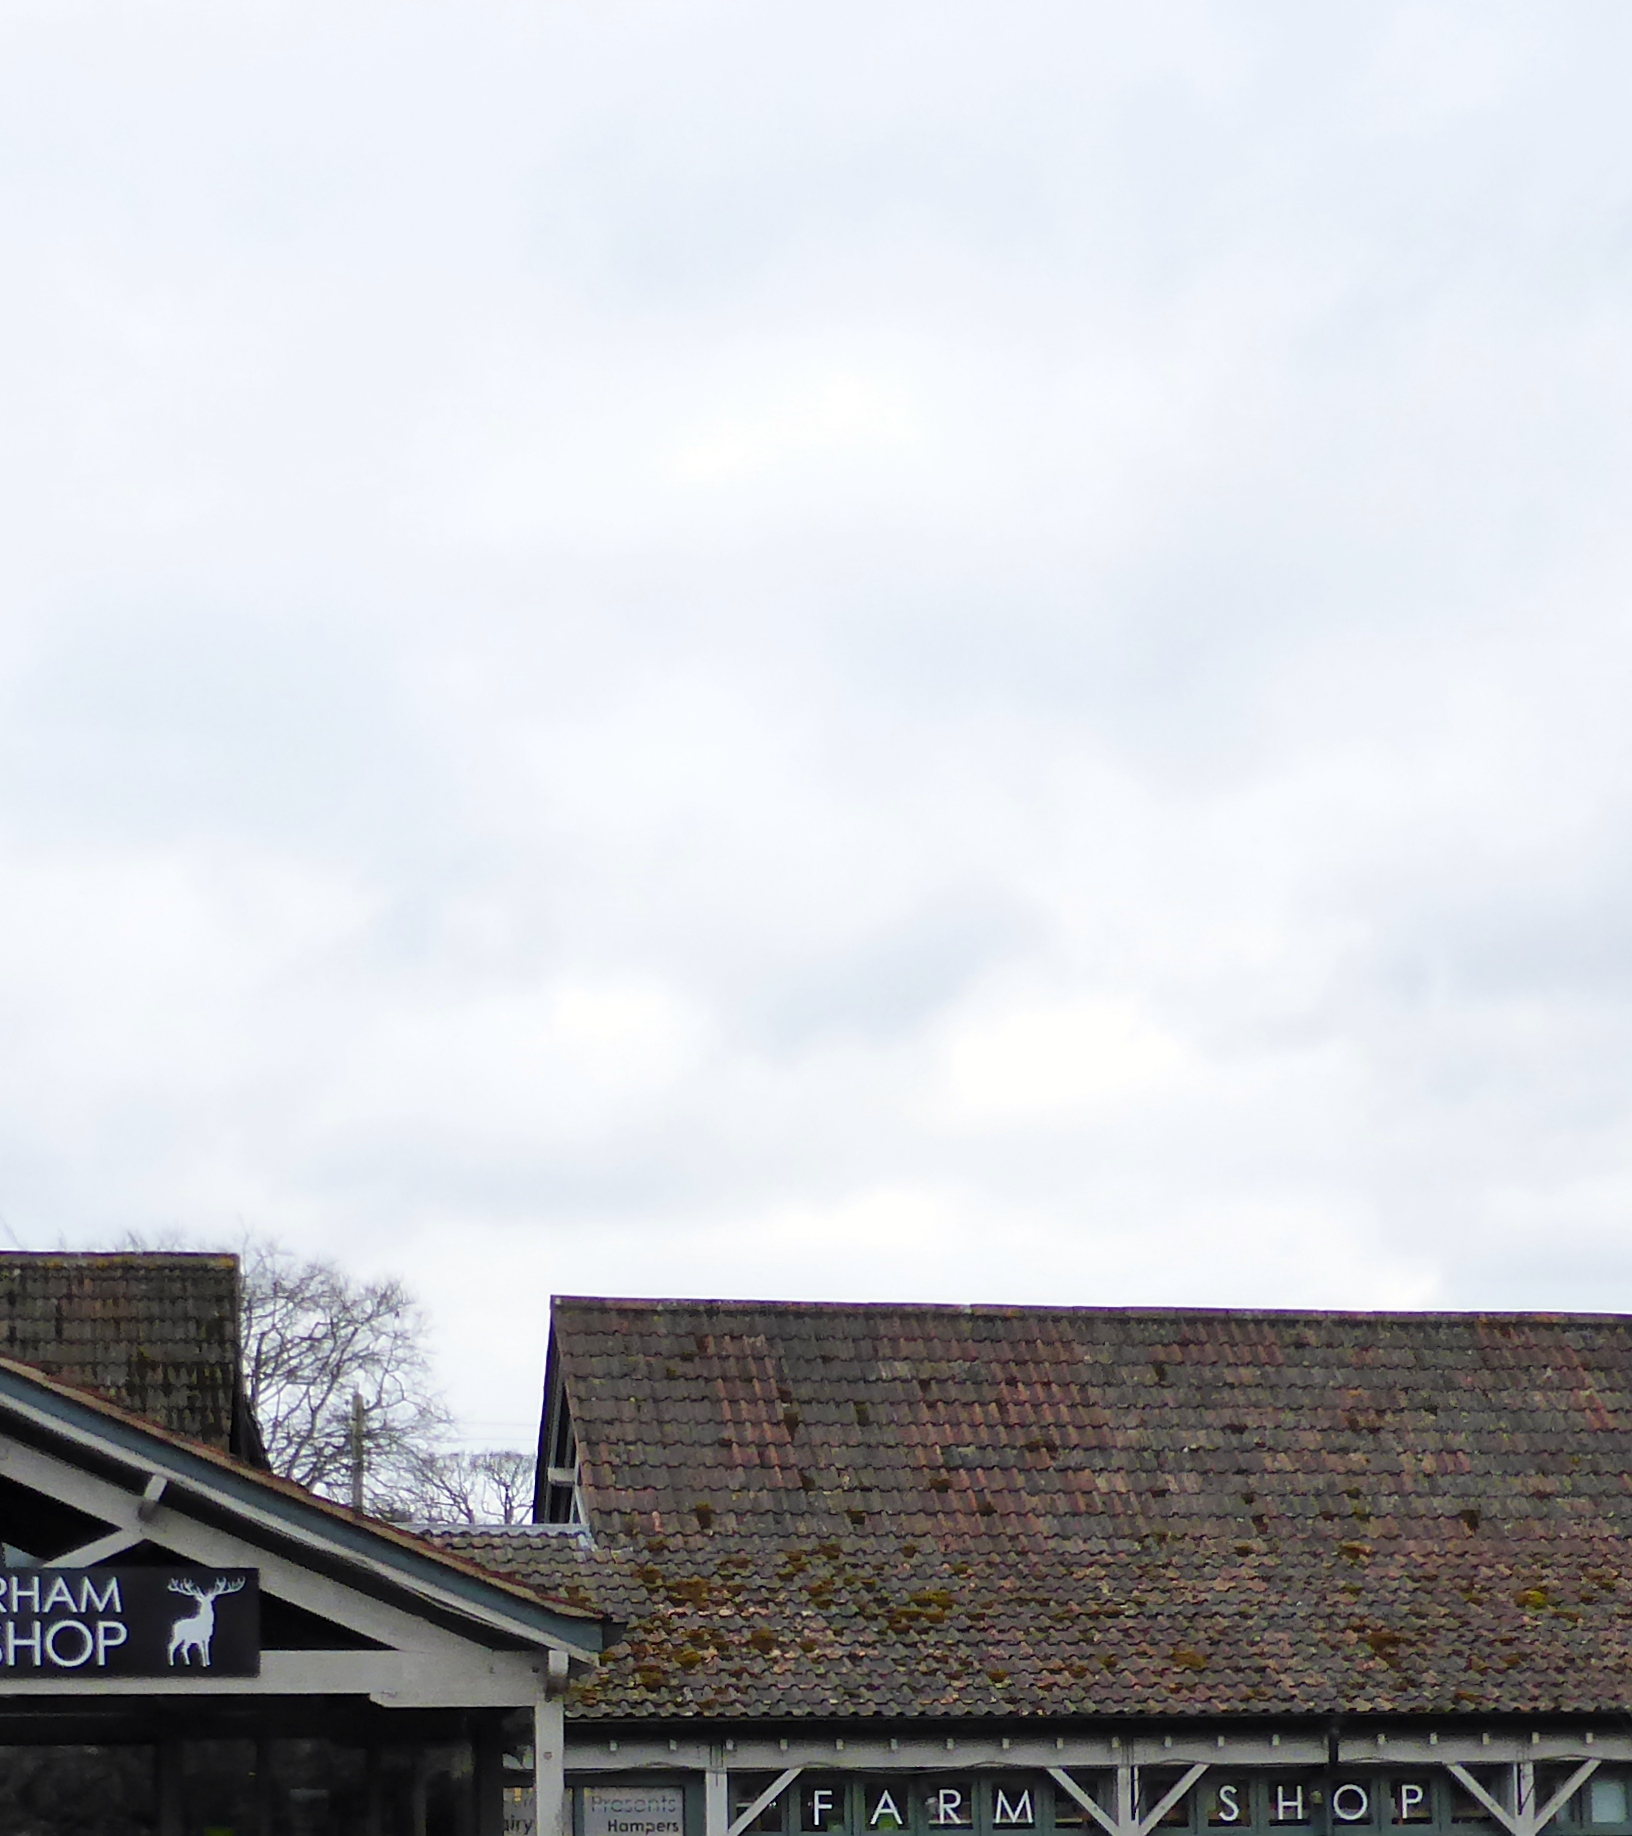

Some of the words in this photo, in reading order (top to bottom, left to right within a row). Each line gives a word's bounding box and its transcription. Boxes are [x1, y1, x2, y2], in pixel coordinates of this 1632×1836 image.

[591, 1795, 676, 1813] Presents
[813, 1788, 1034, 1826] FARM
[1217, 1783, 1424, 1822] SHOP
[607, 1819, 679, 1835] Hampers
